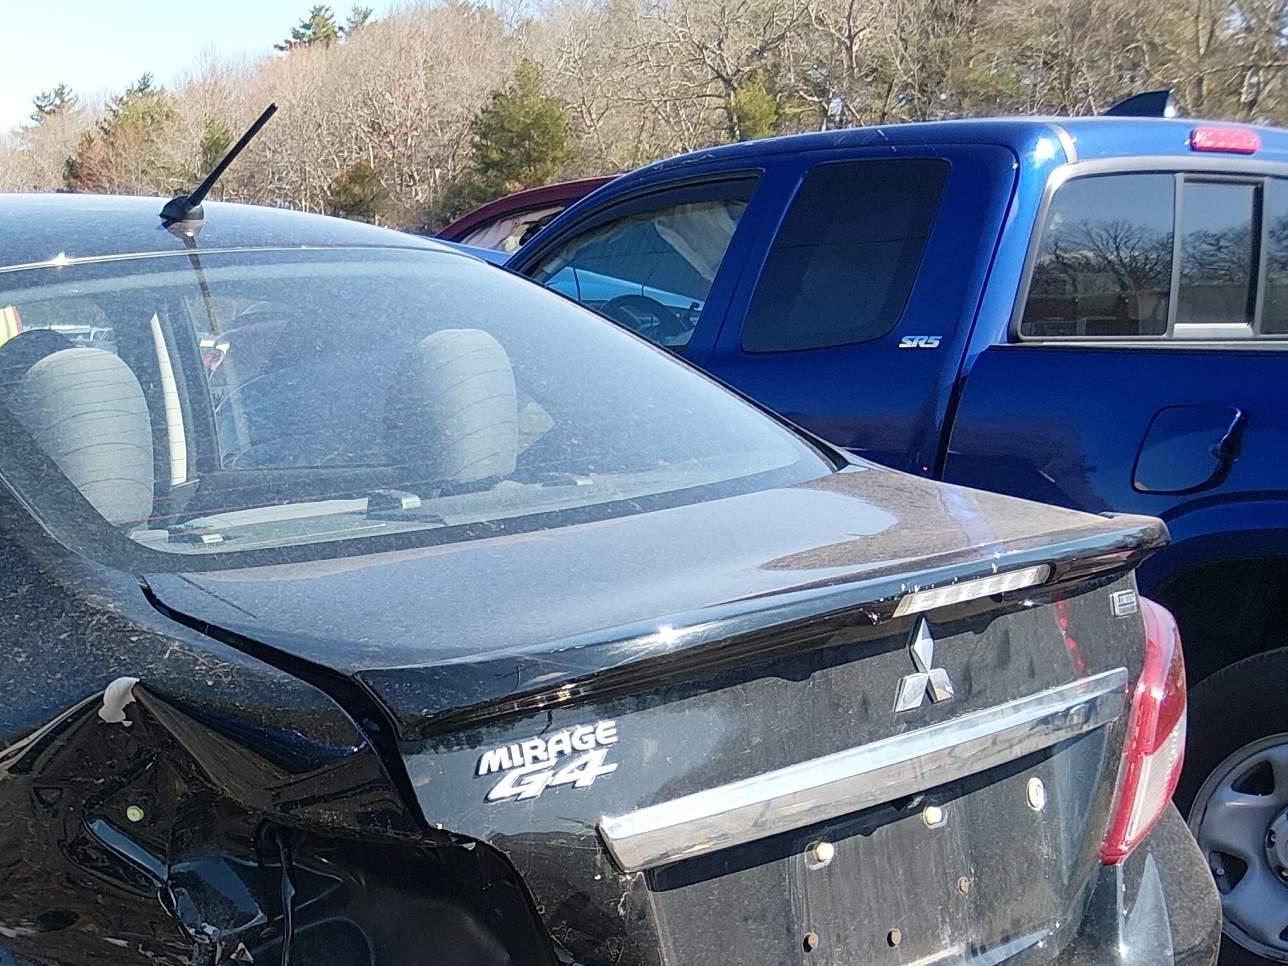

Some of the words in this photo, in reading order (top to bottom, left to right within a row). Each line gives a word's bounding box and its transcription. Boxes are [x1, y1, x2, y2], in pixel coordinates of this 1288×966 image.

[899, 335, 943, 348] SR5
[475, 720, 618, 776] MIRAGE
[485, 748, 618, 801] G4
